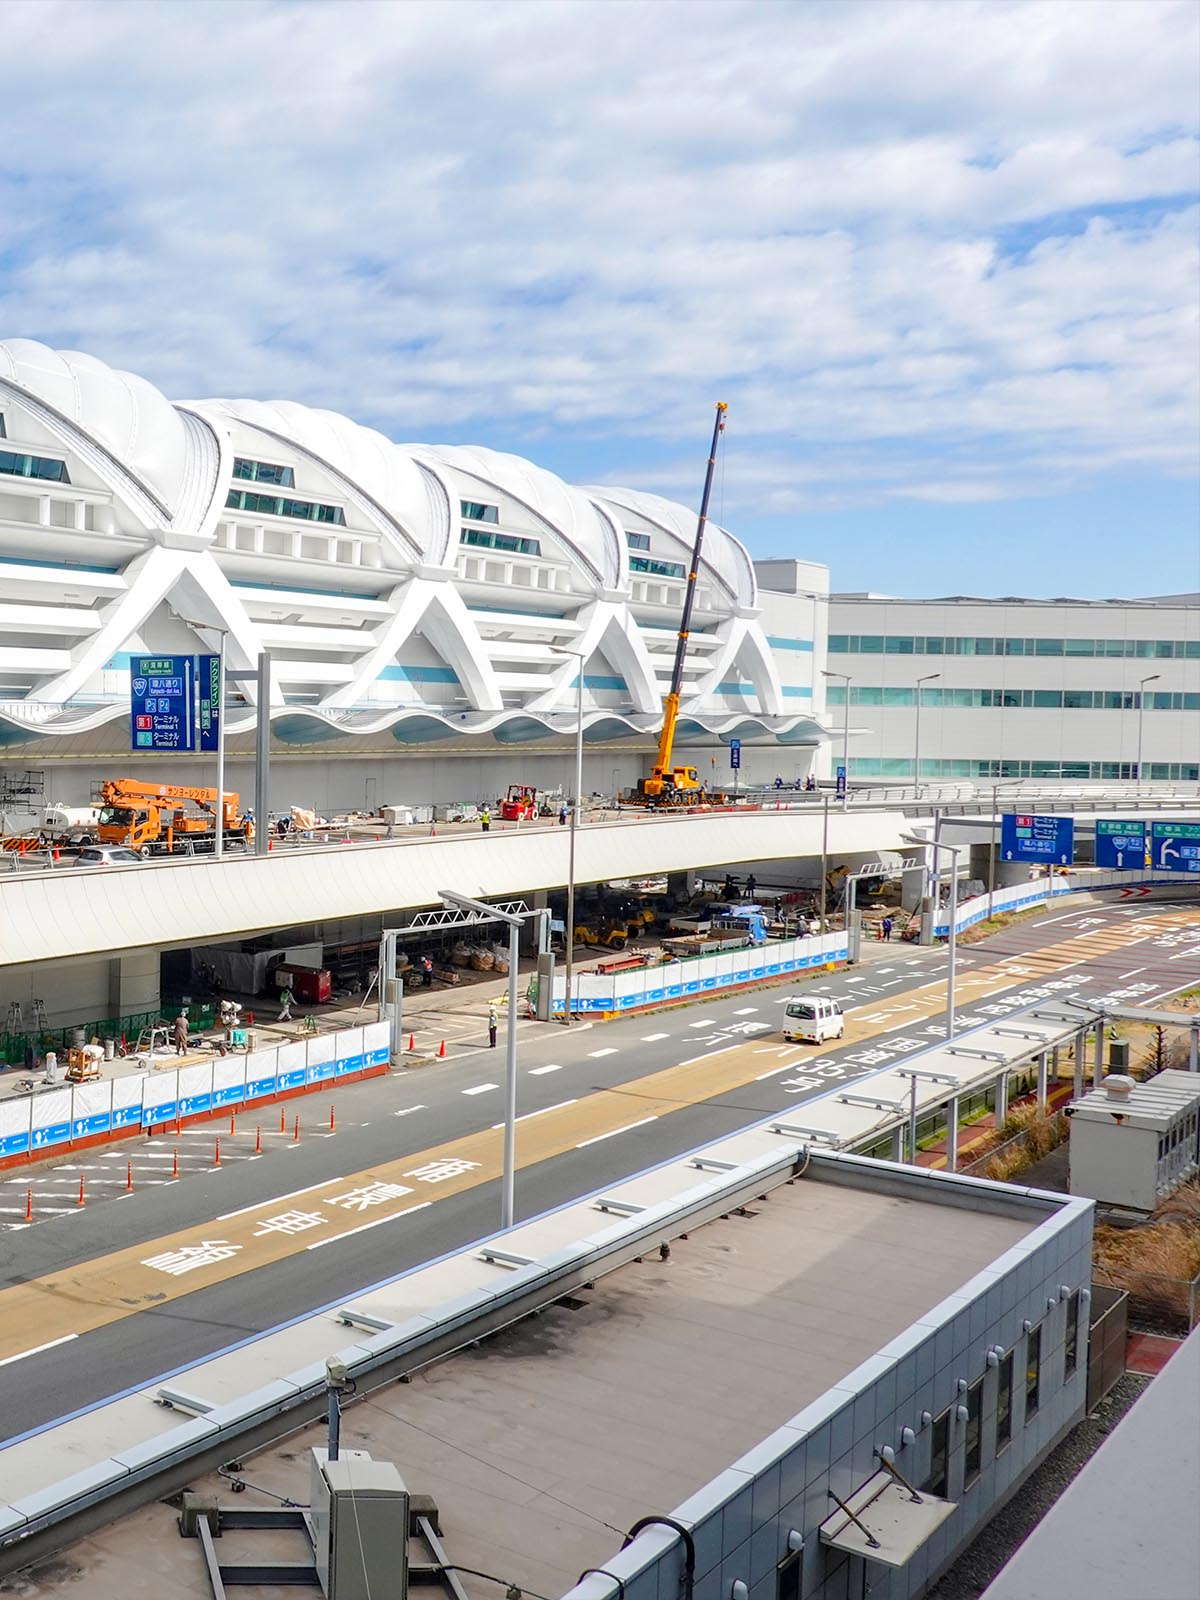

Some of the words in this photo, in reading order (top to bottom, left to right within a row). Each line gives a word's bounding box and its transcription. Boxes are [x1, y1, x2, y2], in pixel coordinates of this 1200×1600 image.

[154, 715, 179, 723] ターミナル
[154, 732, 179, 740] ターミナル
[167, 787, 210, 799] サンヨーレンタル
[139, 1157, 483, 1276] 循環車線
